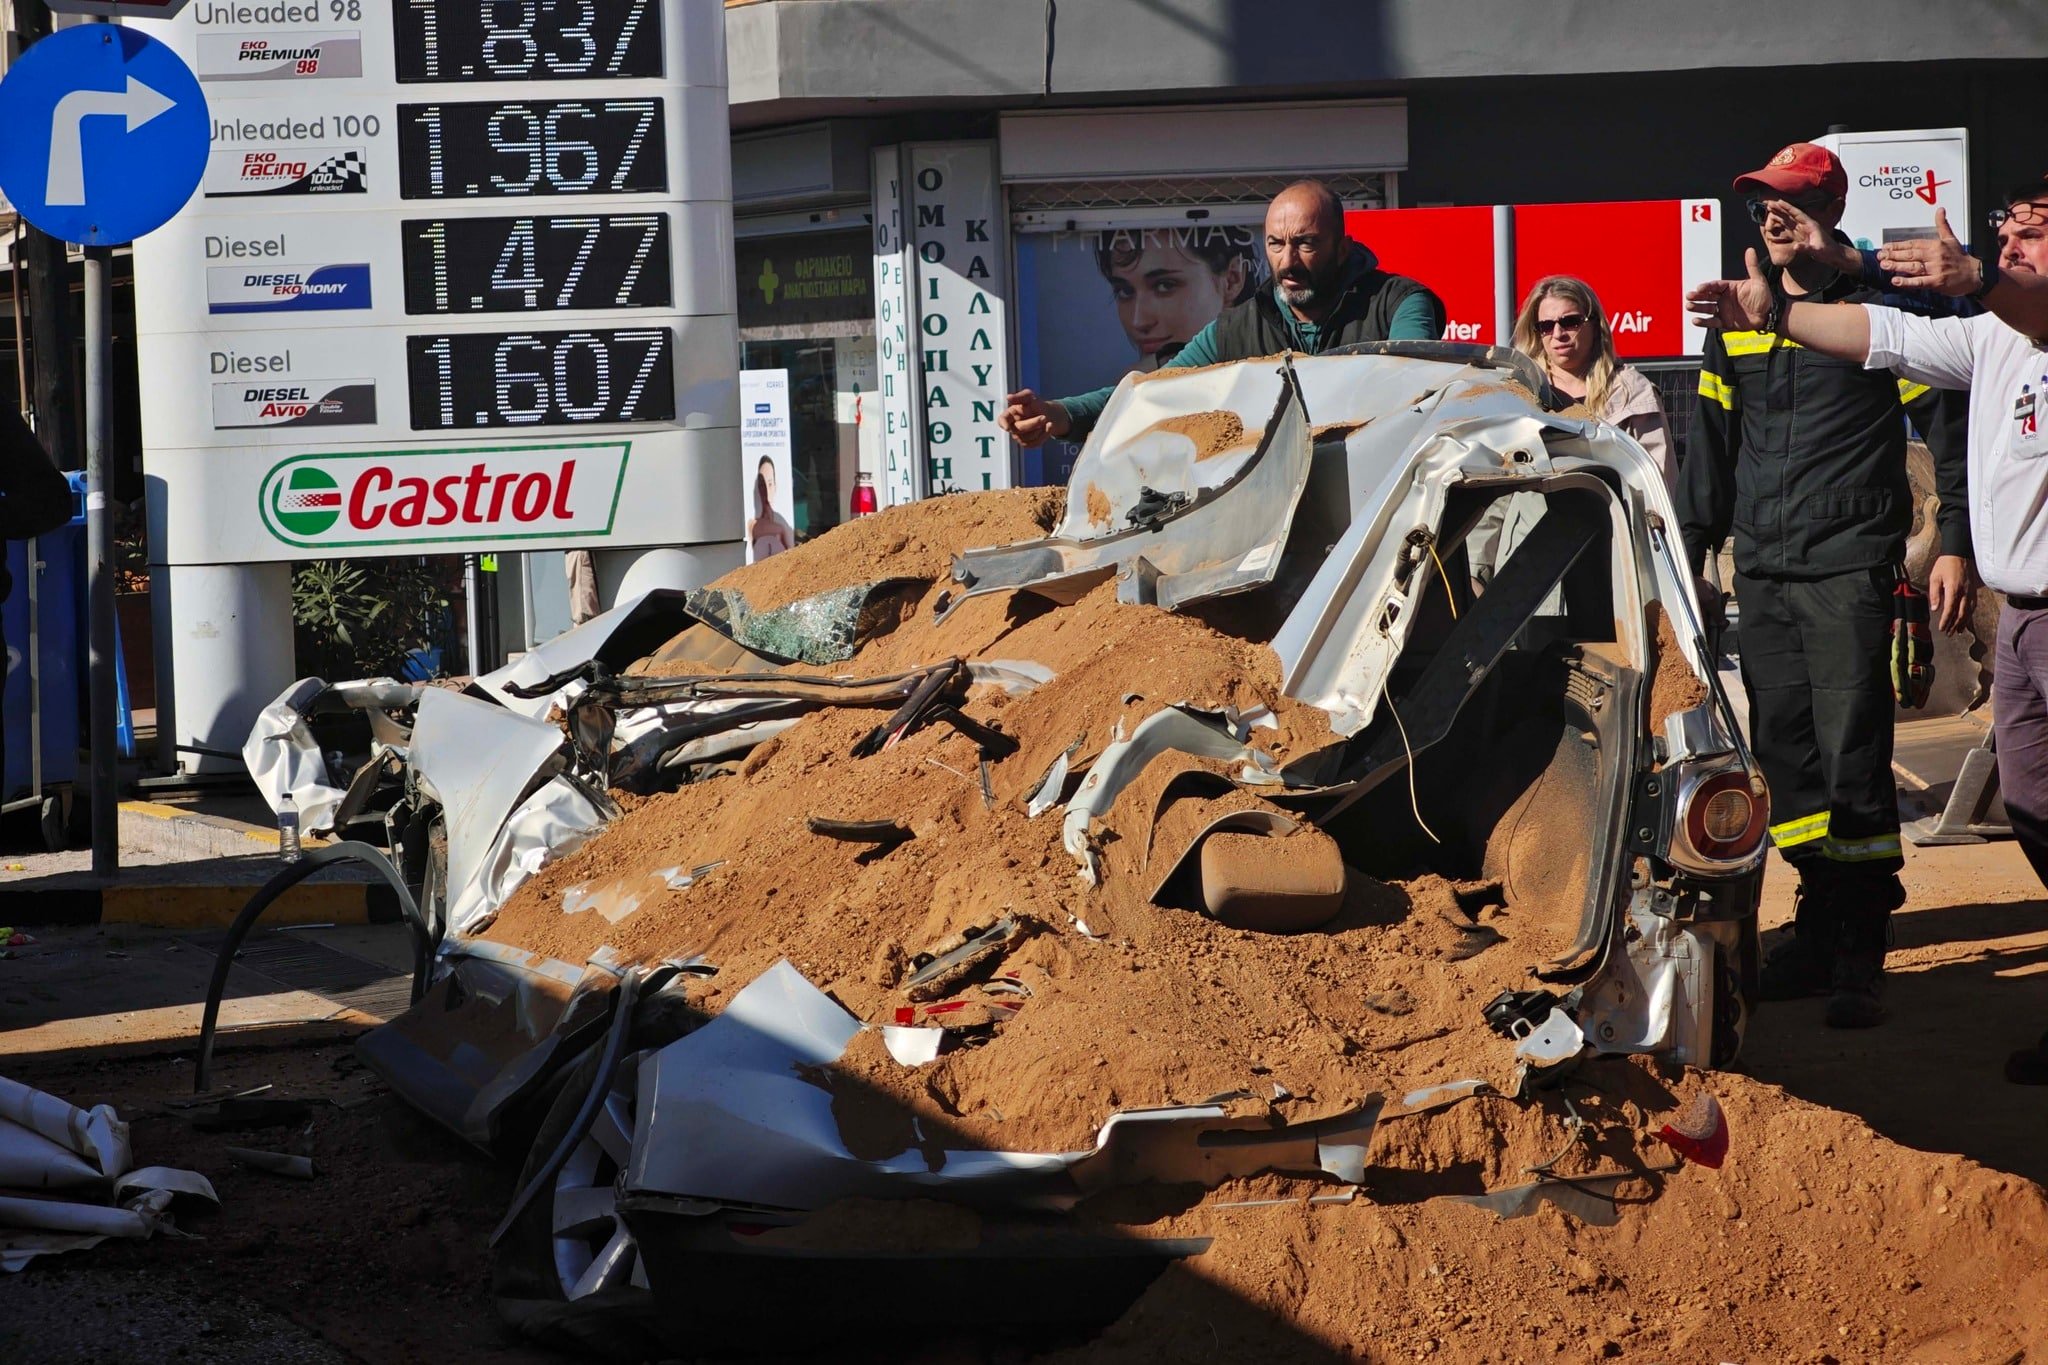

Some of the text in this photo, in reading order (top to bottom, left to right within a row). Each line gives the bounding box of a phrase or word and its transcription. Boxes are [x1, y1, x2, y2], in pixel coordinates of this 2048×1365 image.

[195, 0, 362, 24] Unleaded 98
[241, 41, 267, 50] EKO
[410, 0, 648, 76] 1.837
[238, 49, 320, 61] PREMIUM
[296, 60, 318, 74] 98
[332, 114, 380, 138] 100
[415, 102, 655, 195] 1.967
[244, 153, 276, 163] EKO
[241, 162, 307, 179] racing
[1892, 166, 1920, 174] EKO
[1859, 175, 1922, 188] Charge
[1889, 187, 1914, 200] Go
[205, 234, 286, 259] Diesel
[419, 216, 659, 310] 1.477
[244, 274, 304, 287] DIESEL
[272, 283, 348, 295] EKONOMY
[210, 349, 291, 374] Diesel
[424, 331, 664, 425] 1.607
[244, 388, 310, 402] DIESEL
[348, 459, 576, 530] Castrol
